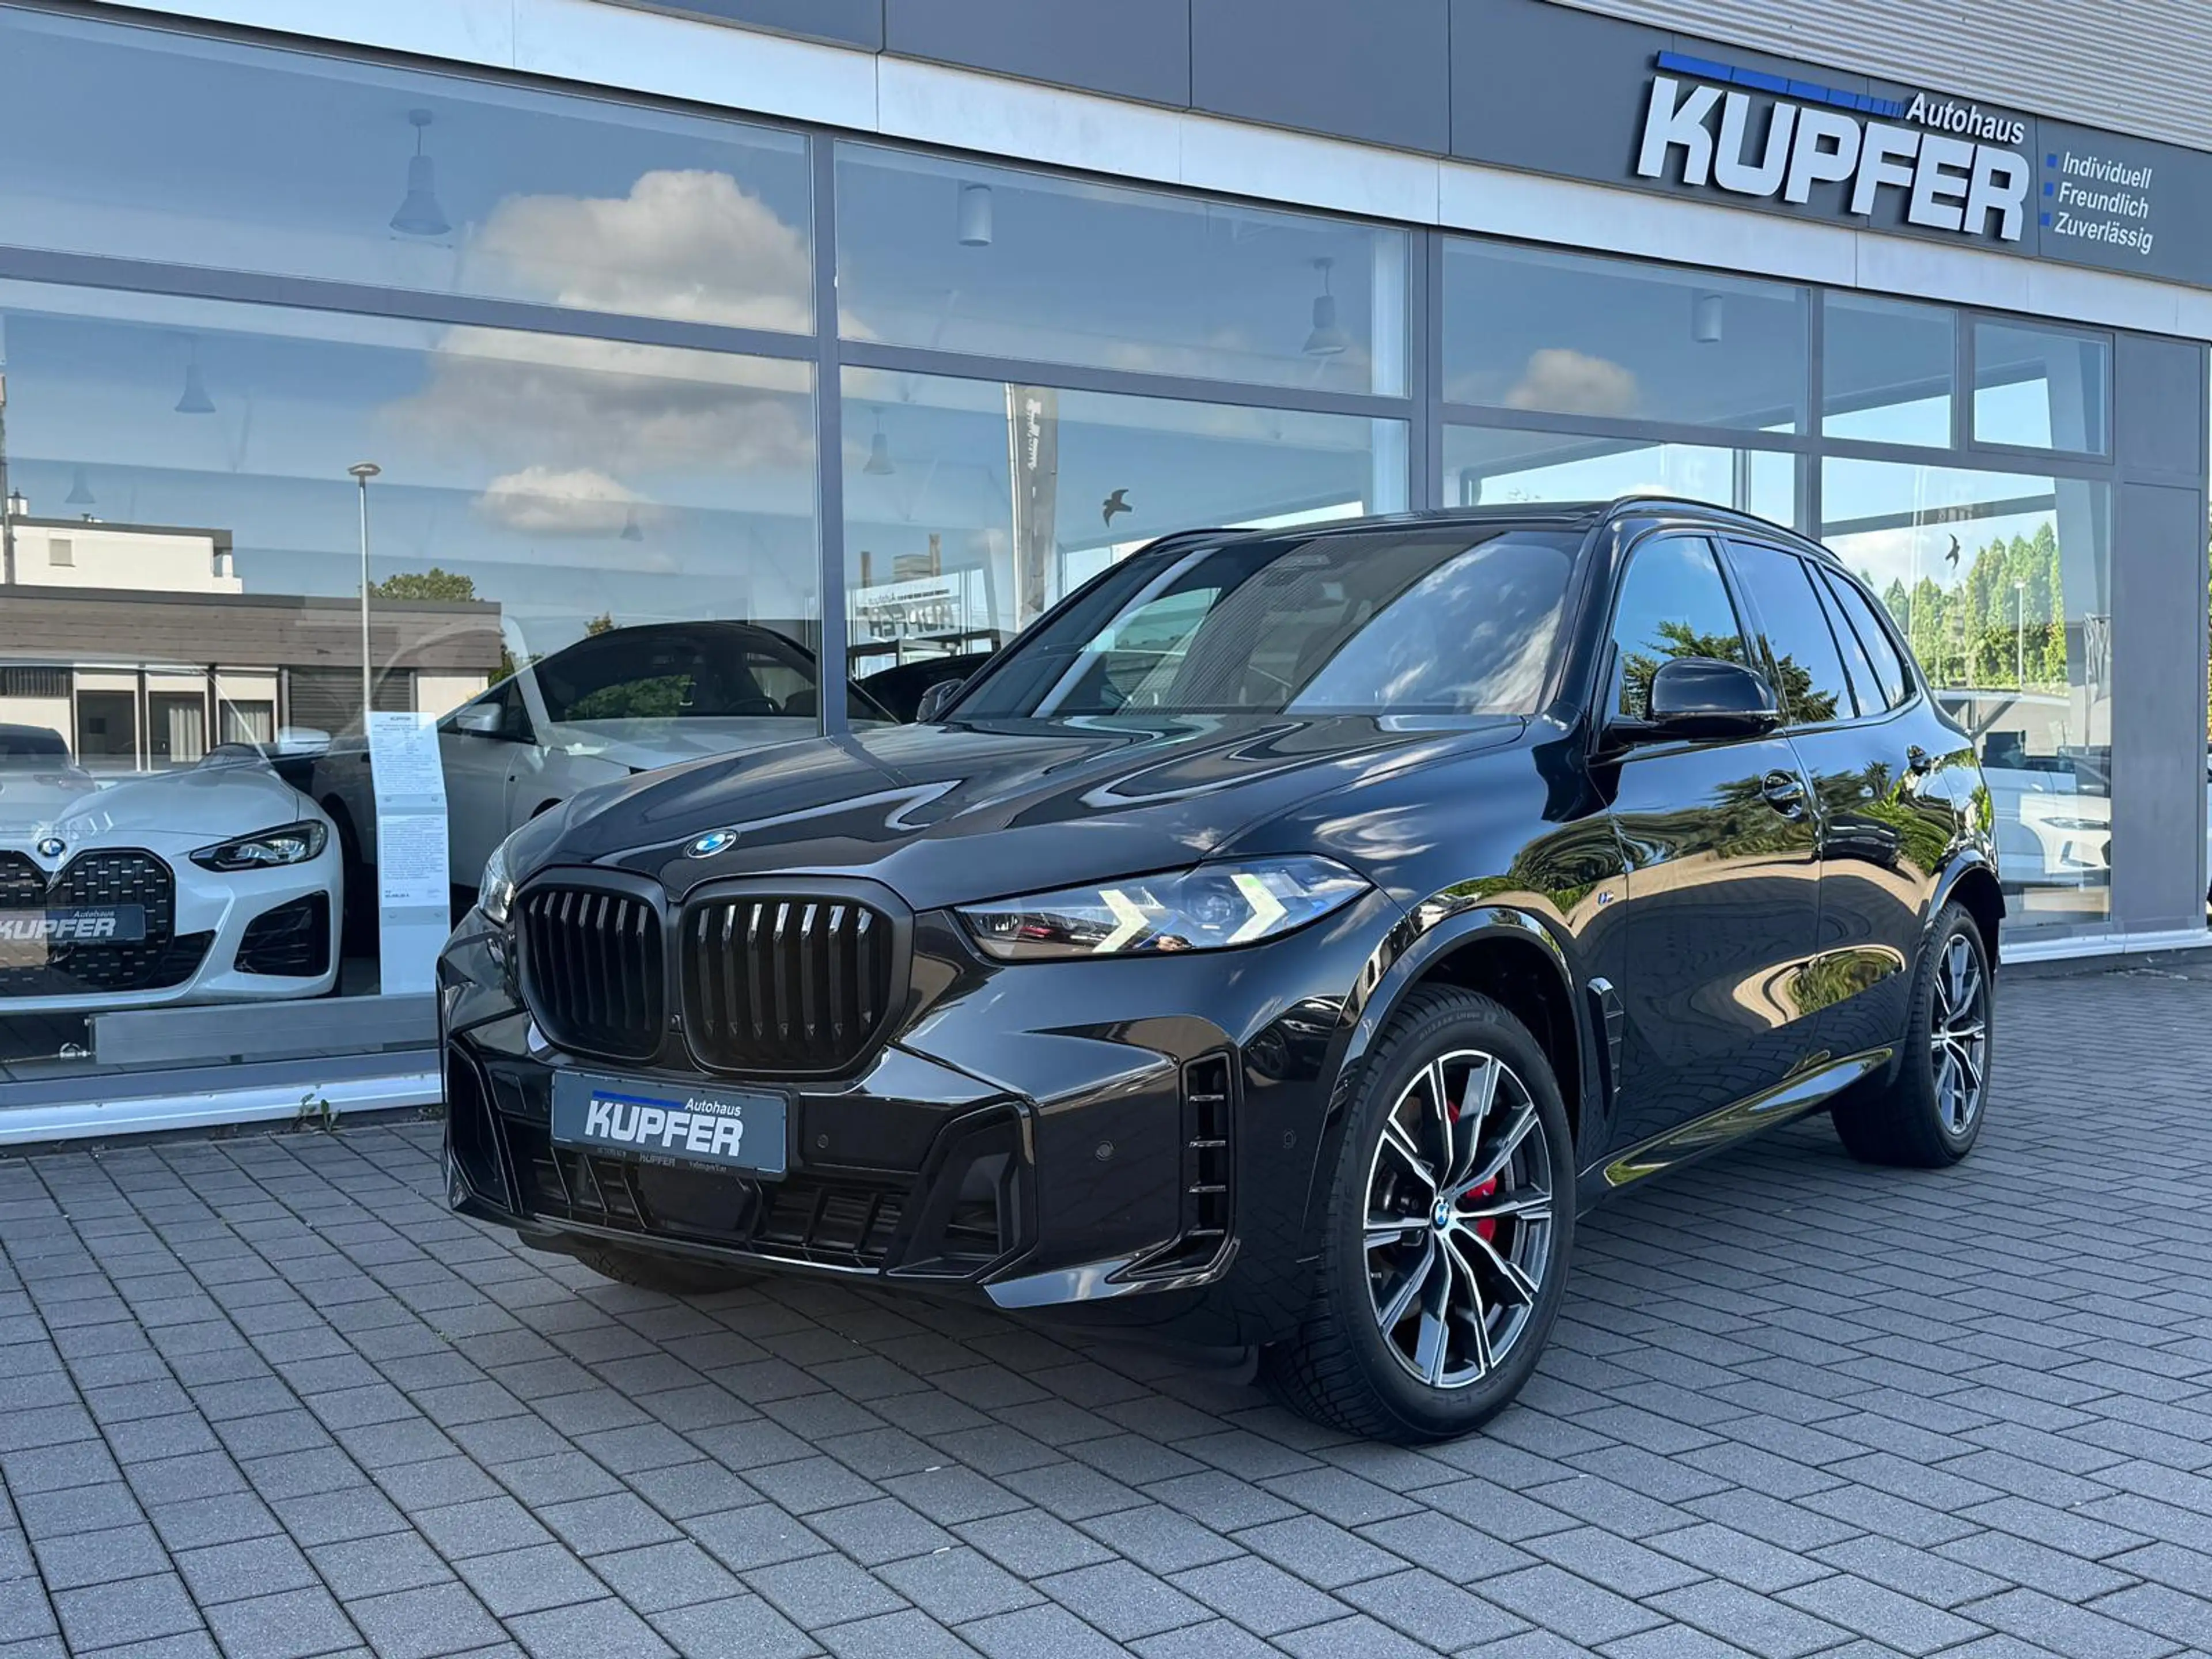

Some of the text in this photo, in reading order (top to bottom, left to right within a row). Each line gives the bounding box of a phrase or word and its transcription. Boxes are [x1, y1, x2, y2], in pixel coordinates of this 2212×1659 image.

[1906, 92, 2025, 145] Autohaus
[1637, 75, 2031, 242] KUPFER
[2062, 151, 2153, 190] Individuell
[2058, 181, 2150, 219] Freundlich
[2054, 211, 2154, 255] Zuverlässig
[585, 1100, 744, 1157] KUPFER
[684, 1097, 741, 1116] Autohaus
